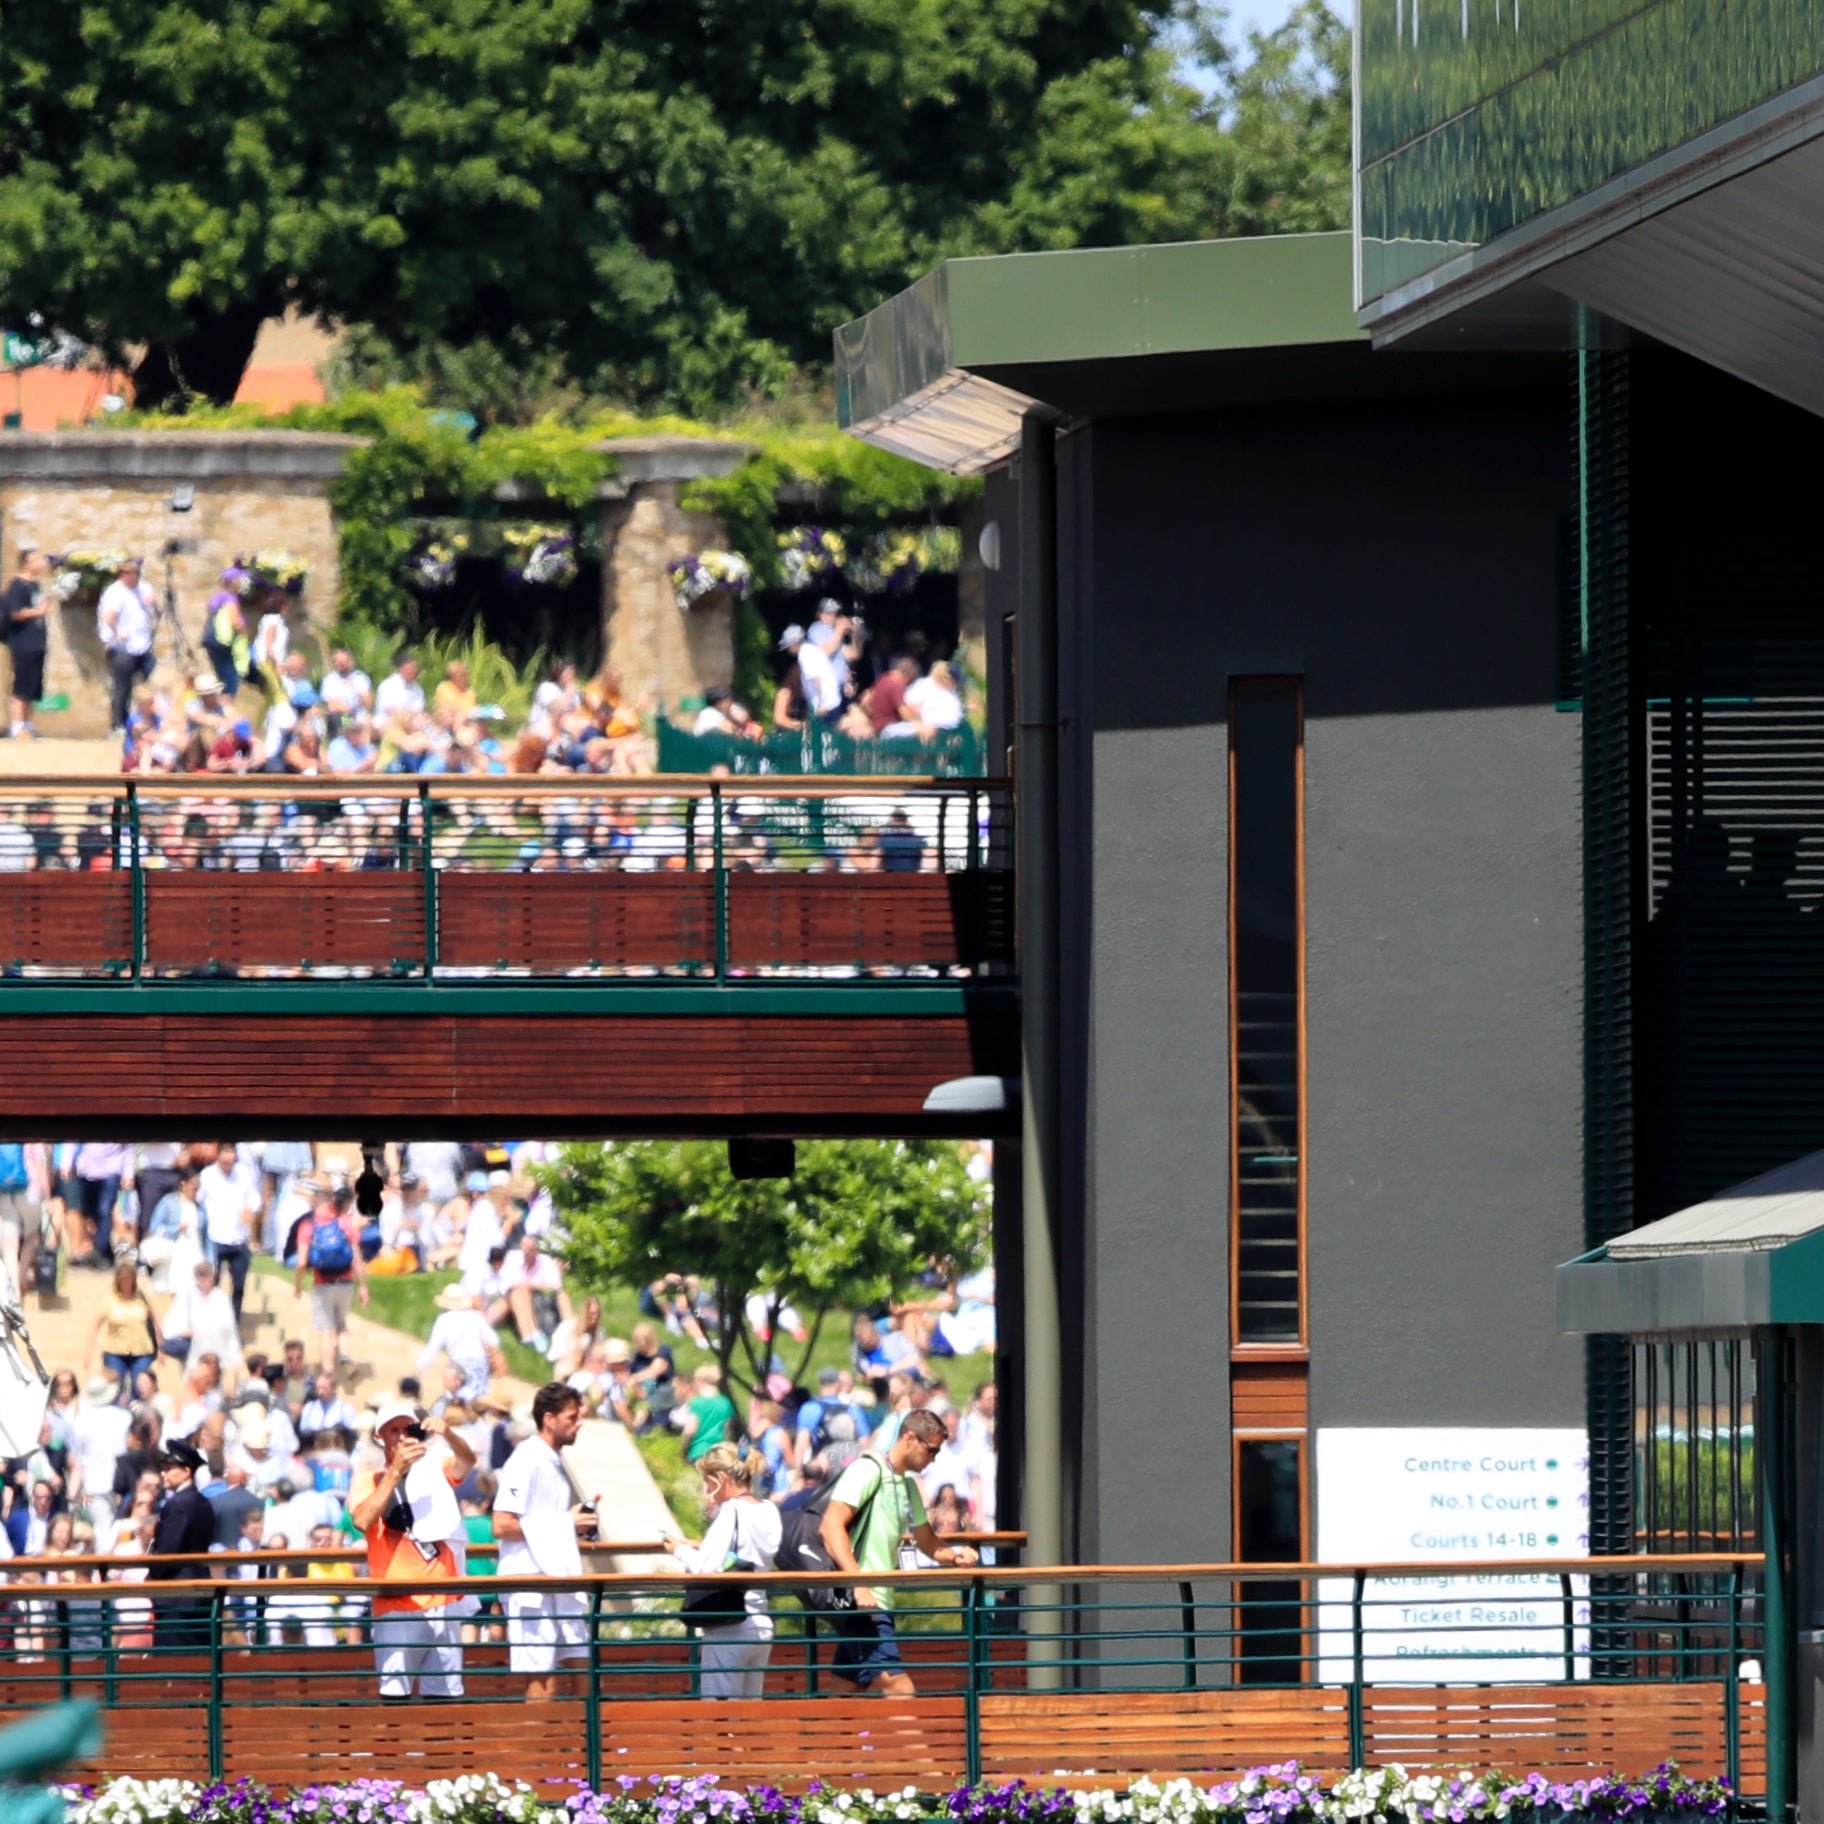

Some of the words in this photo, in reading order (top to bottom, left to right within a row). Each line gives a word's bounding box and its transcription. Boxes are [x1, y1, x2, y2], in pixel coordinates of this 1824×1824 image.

[1404, 1457, 1472, 1472] Centre
[1480, 1456, 1537, 1472] Court
[1481, 1493, 1537, 1510] Court
[1410, 1532, 1479, 1548] Courts
[1487, 1531, 1537, 1548] 14-18
[1401, 1608, 1462, 1623] Ticket
[1470, 1606, 1537, 1623] Resale
